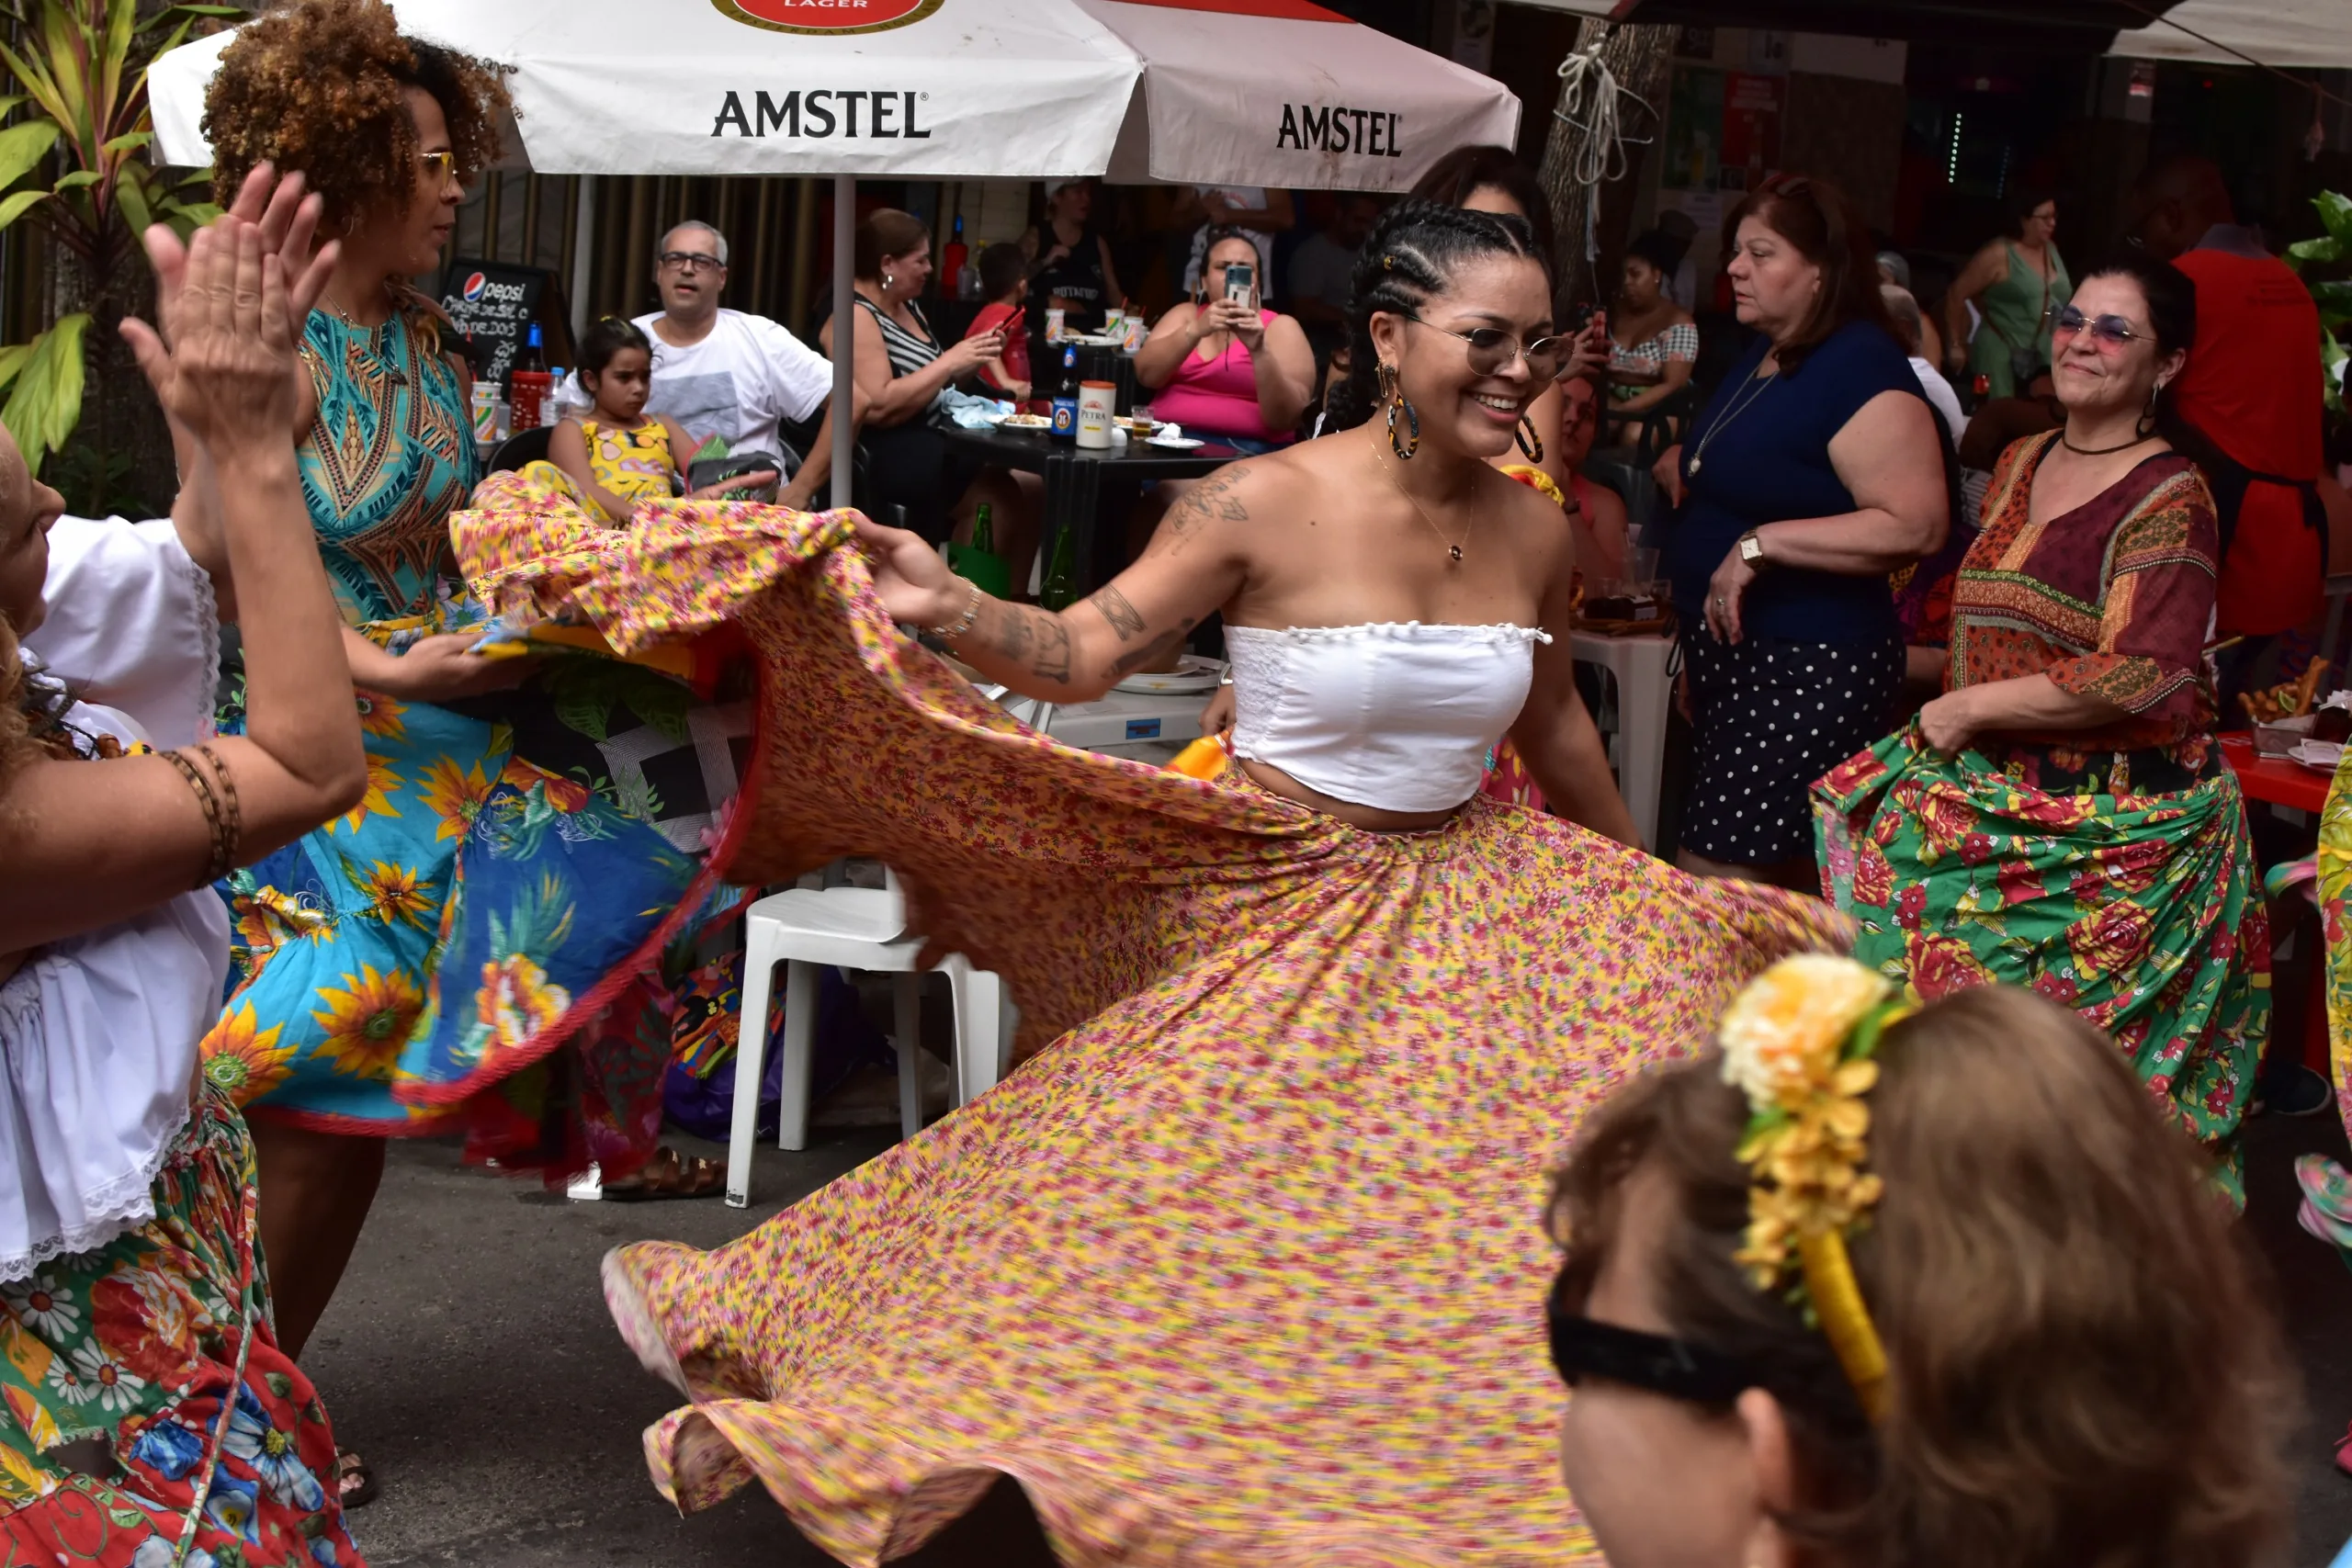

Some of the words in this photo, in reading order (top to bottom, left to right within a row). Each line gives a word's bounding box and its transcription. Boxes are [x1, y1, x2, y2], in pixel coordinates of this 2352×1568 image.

[710, 90, 932, 138] AMSTEL
[1276, 104, 1402, 157] AMSTEL
[482, 283, 526, 302] pepsi
[1080, 410, 1106, 421] PETRA
